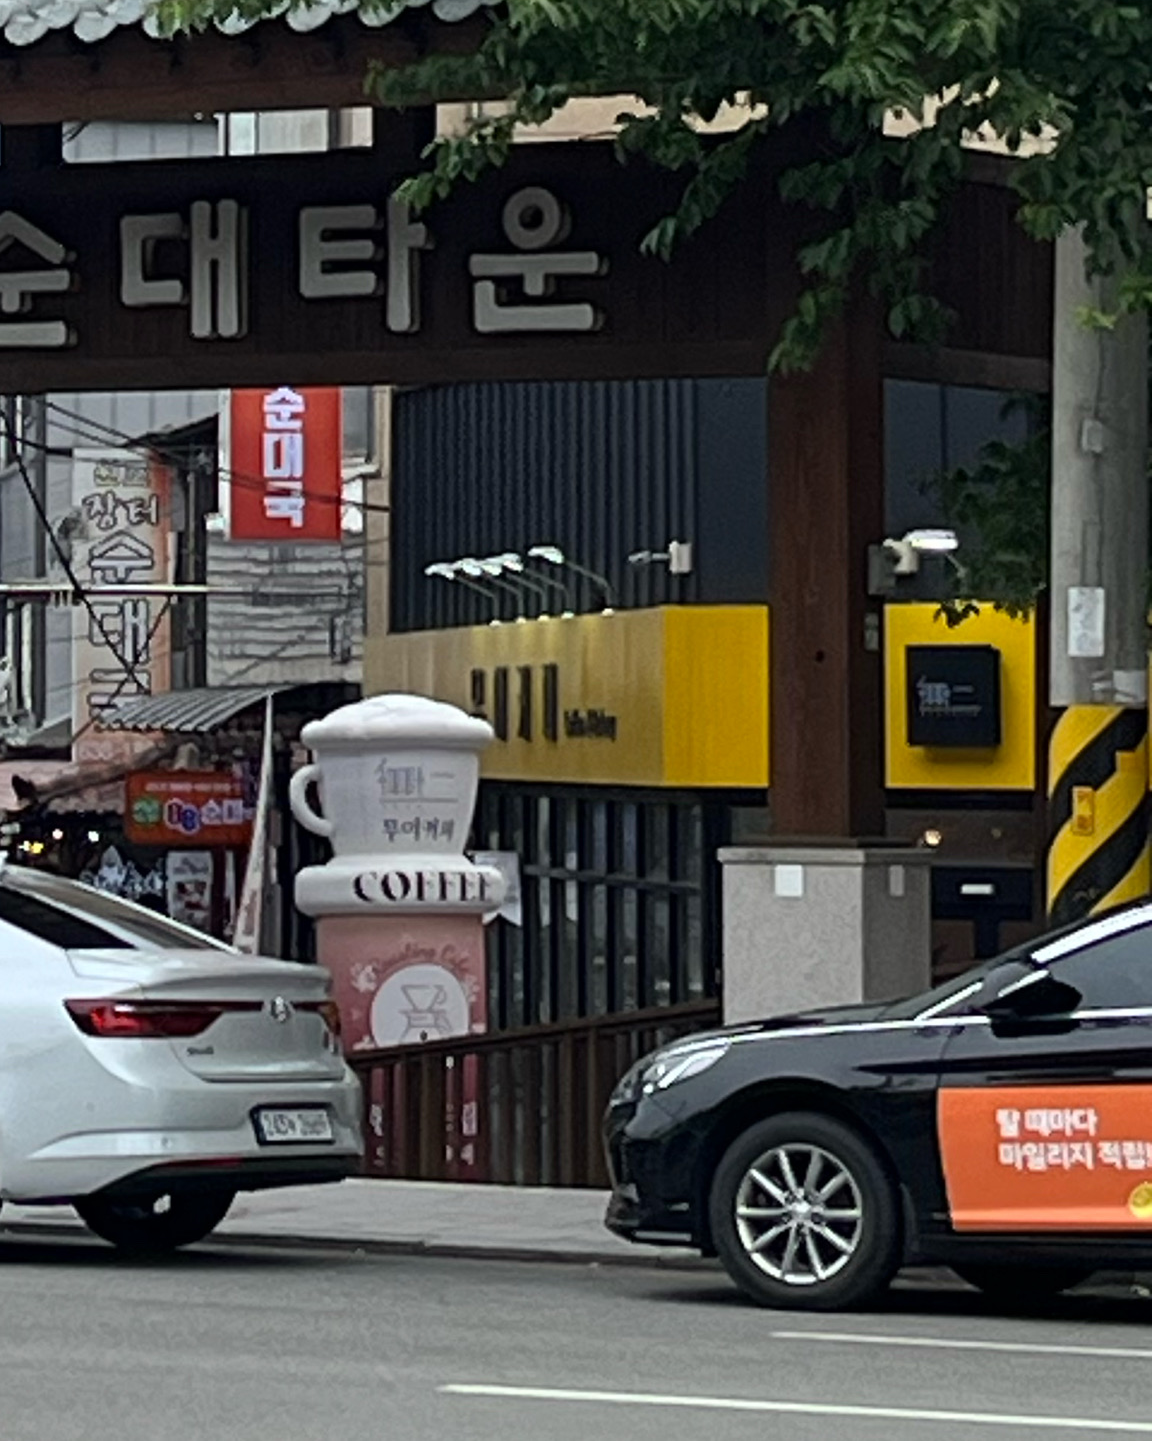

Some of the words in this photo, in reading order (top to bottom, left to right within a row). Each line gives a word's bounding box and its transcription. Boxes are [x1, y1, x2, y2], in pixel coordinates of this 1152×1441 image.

[262, 386, 306, 528] 순대국
[82, 488, 159, 530] 장터
[1024, 1108, 1097, 1137] 때마다
[1098, 1141, 1152, 1170] 적립
